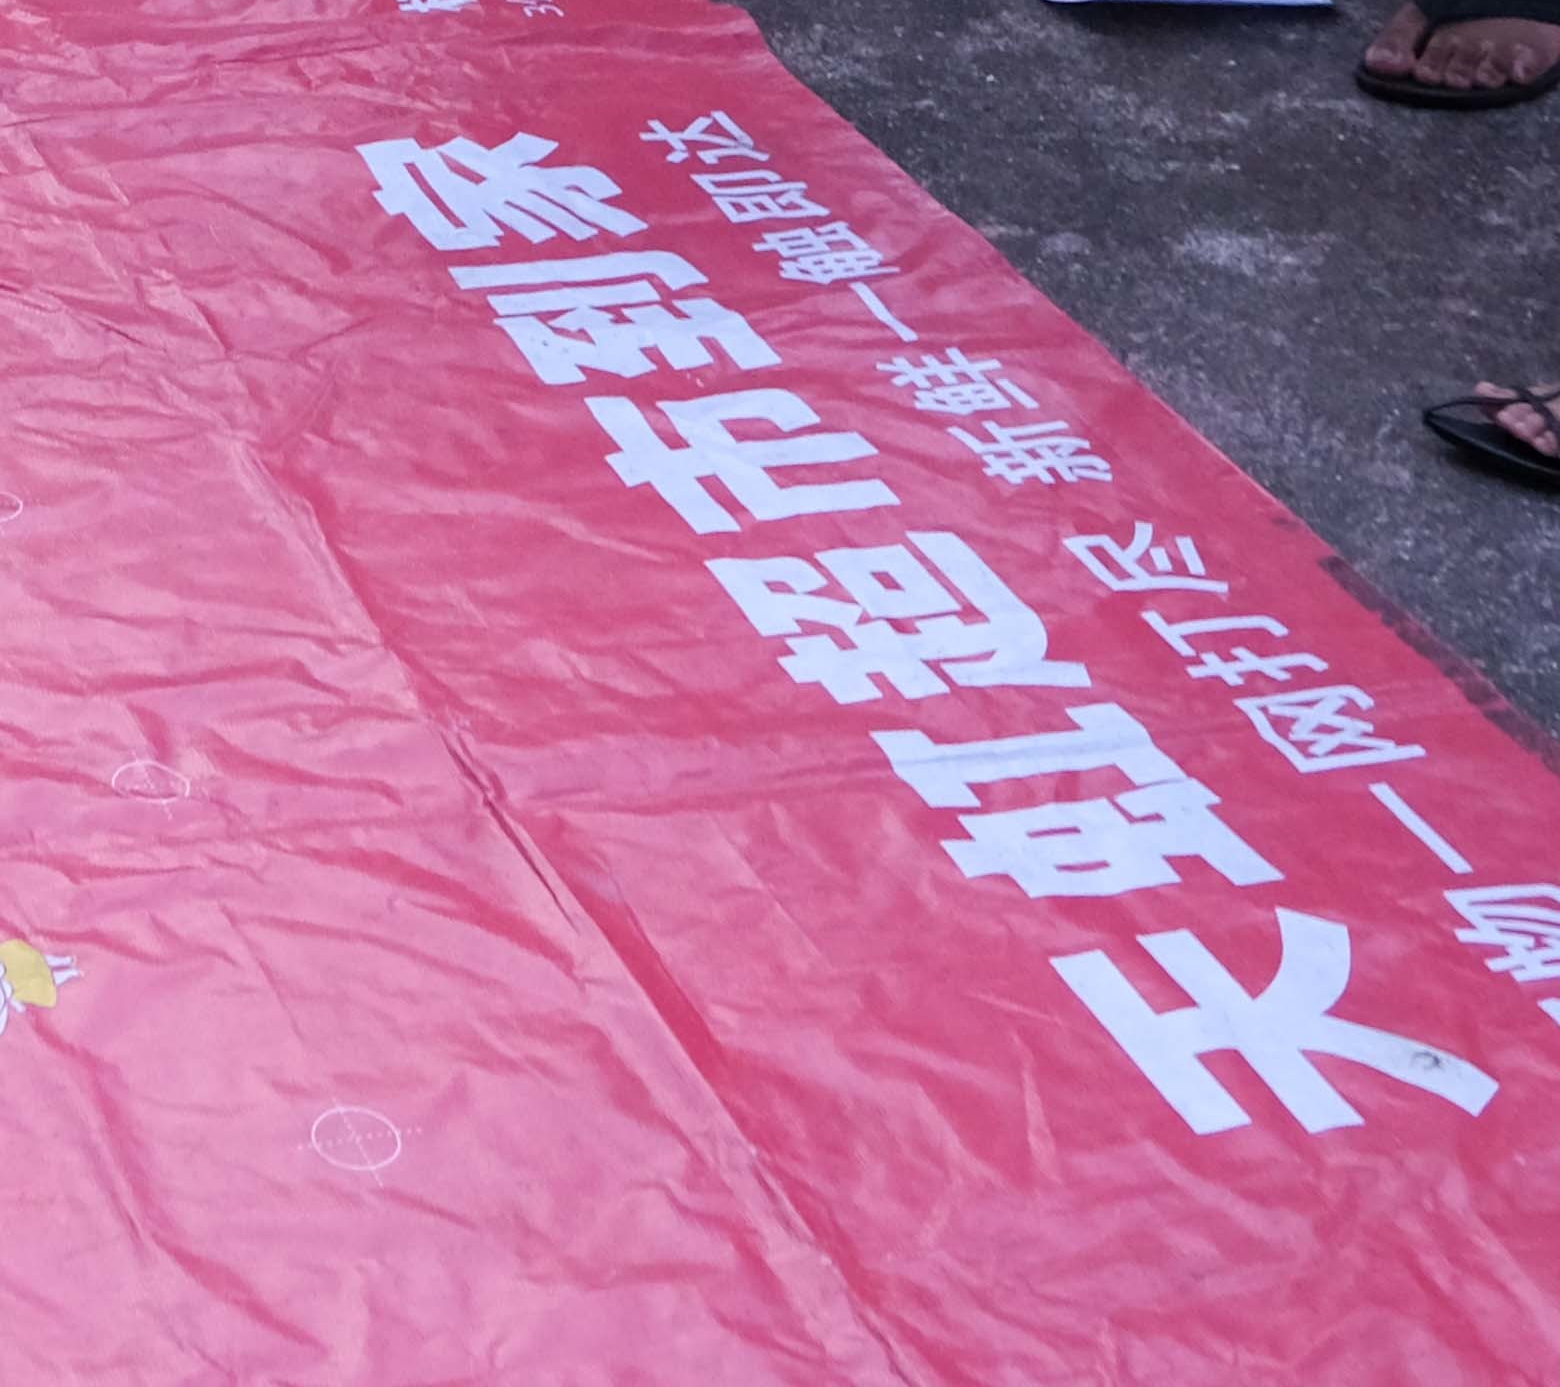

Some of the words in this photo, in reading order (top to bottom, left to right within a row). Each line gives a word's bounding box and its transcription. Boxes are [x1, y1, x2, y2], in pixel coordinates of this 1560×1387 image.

[355, 129, 1500, 1137] 天虹超市到家
[638, 108, 1113, 488] 新鲜一触即达
